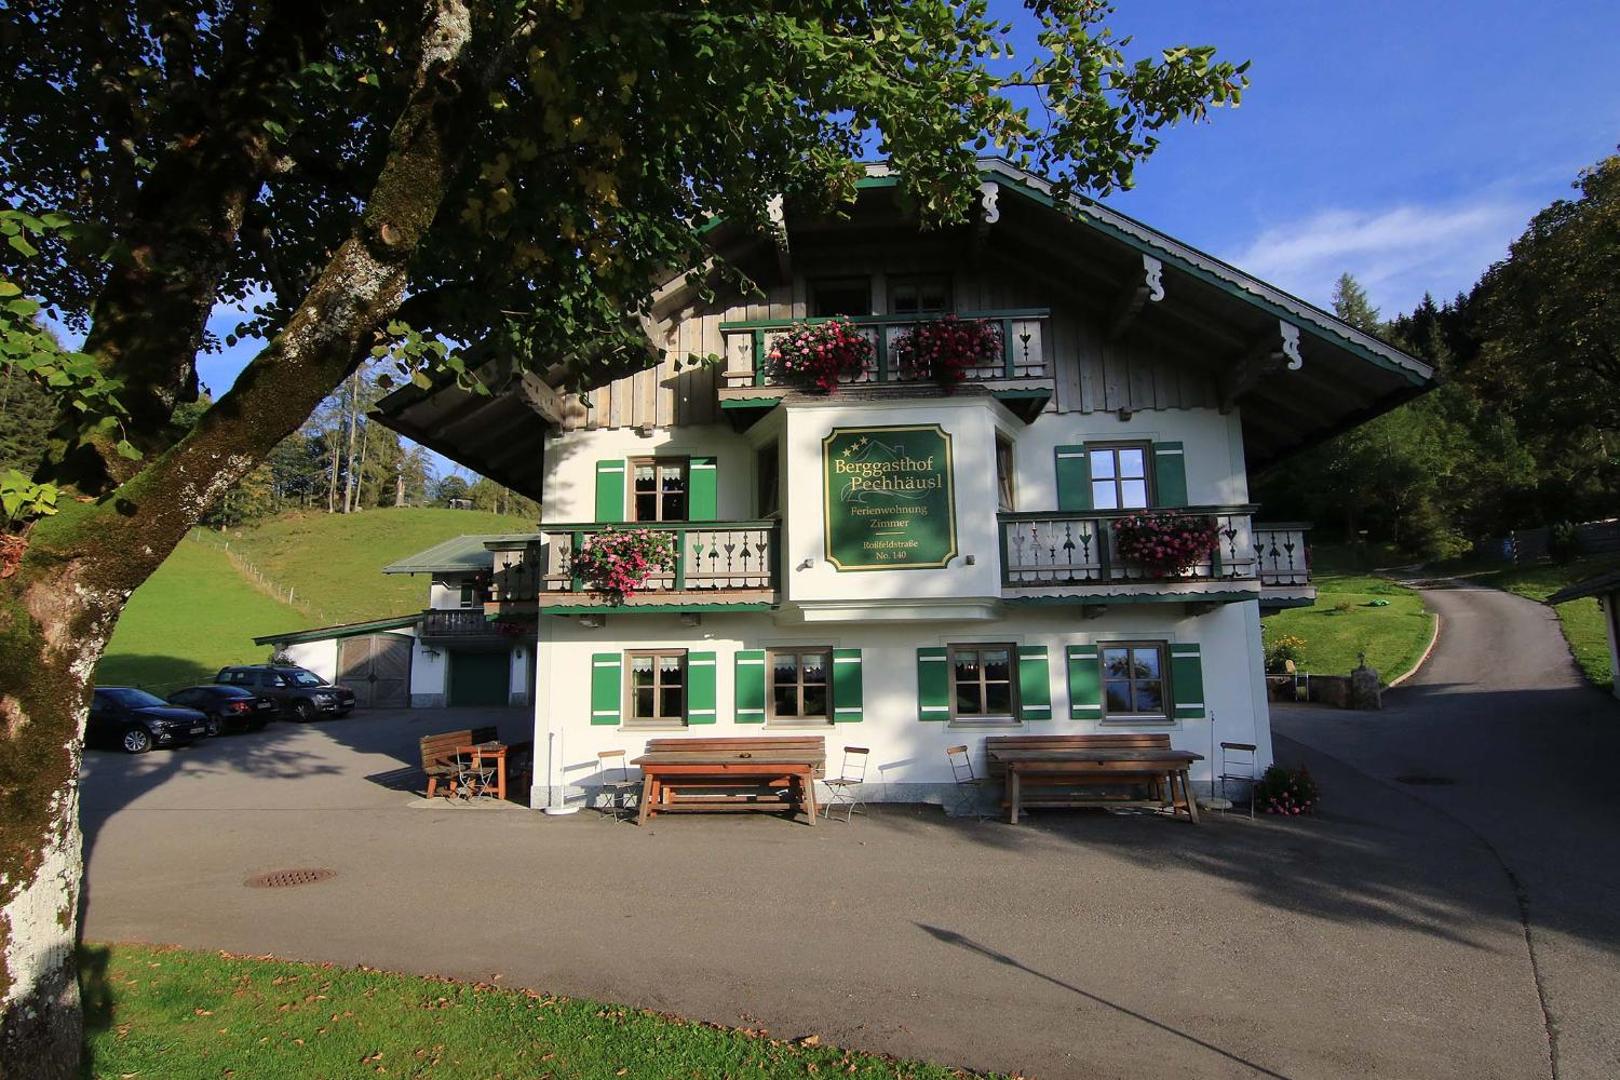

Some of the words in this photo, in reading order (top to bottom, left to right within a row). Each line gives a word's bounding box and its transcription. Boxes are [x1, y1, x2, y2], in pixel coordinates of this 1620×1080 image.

[835, 456, 933, 477] Berggasthof
[851, 474, 942, 491] Pechhäusl
[850, 505, 928, 515] Ferienwohnung
[870, 519, 910, 528] Zimmer
[876, 552, 891, 560] No.
